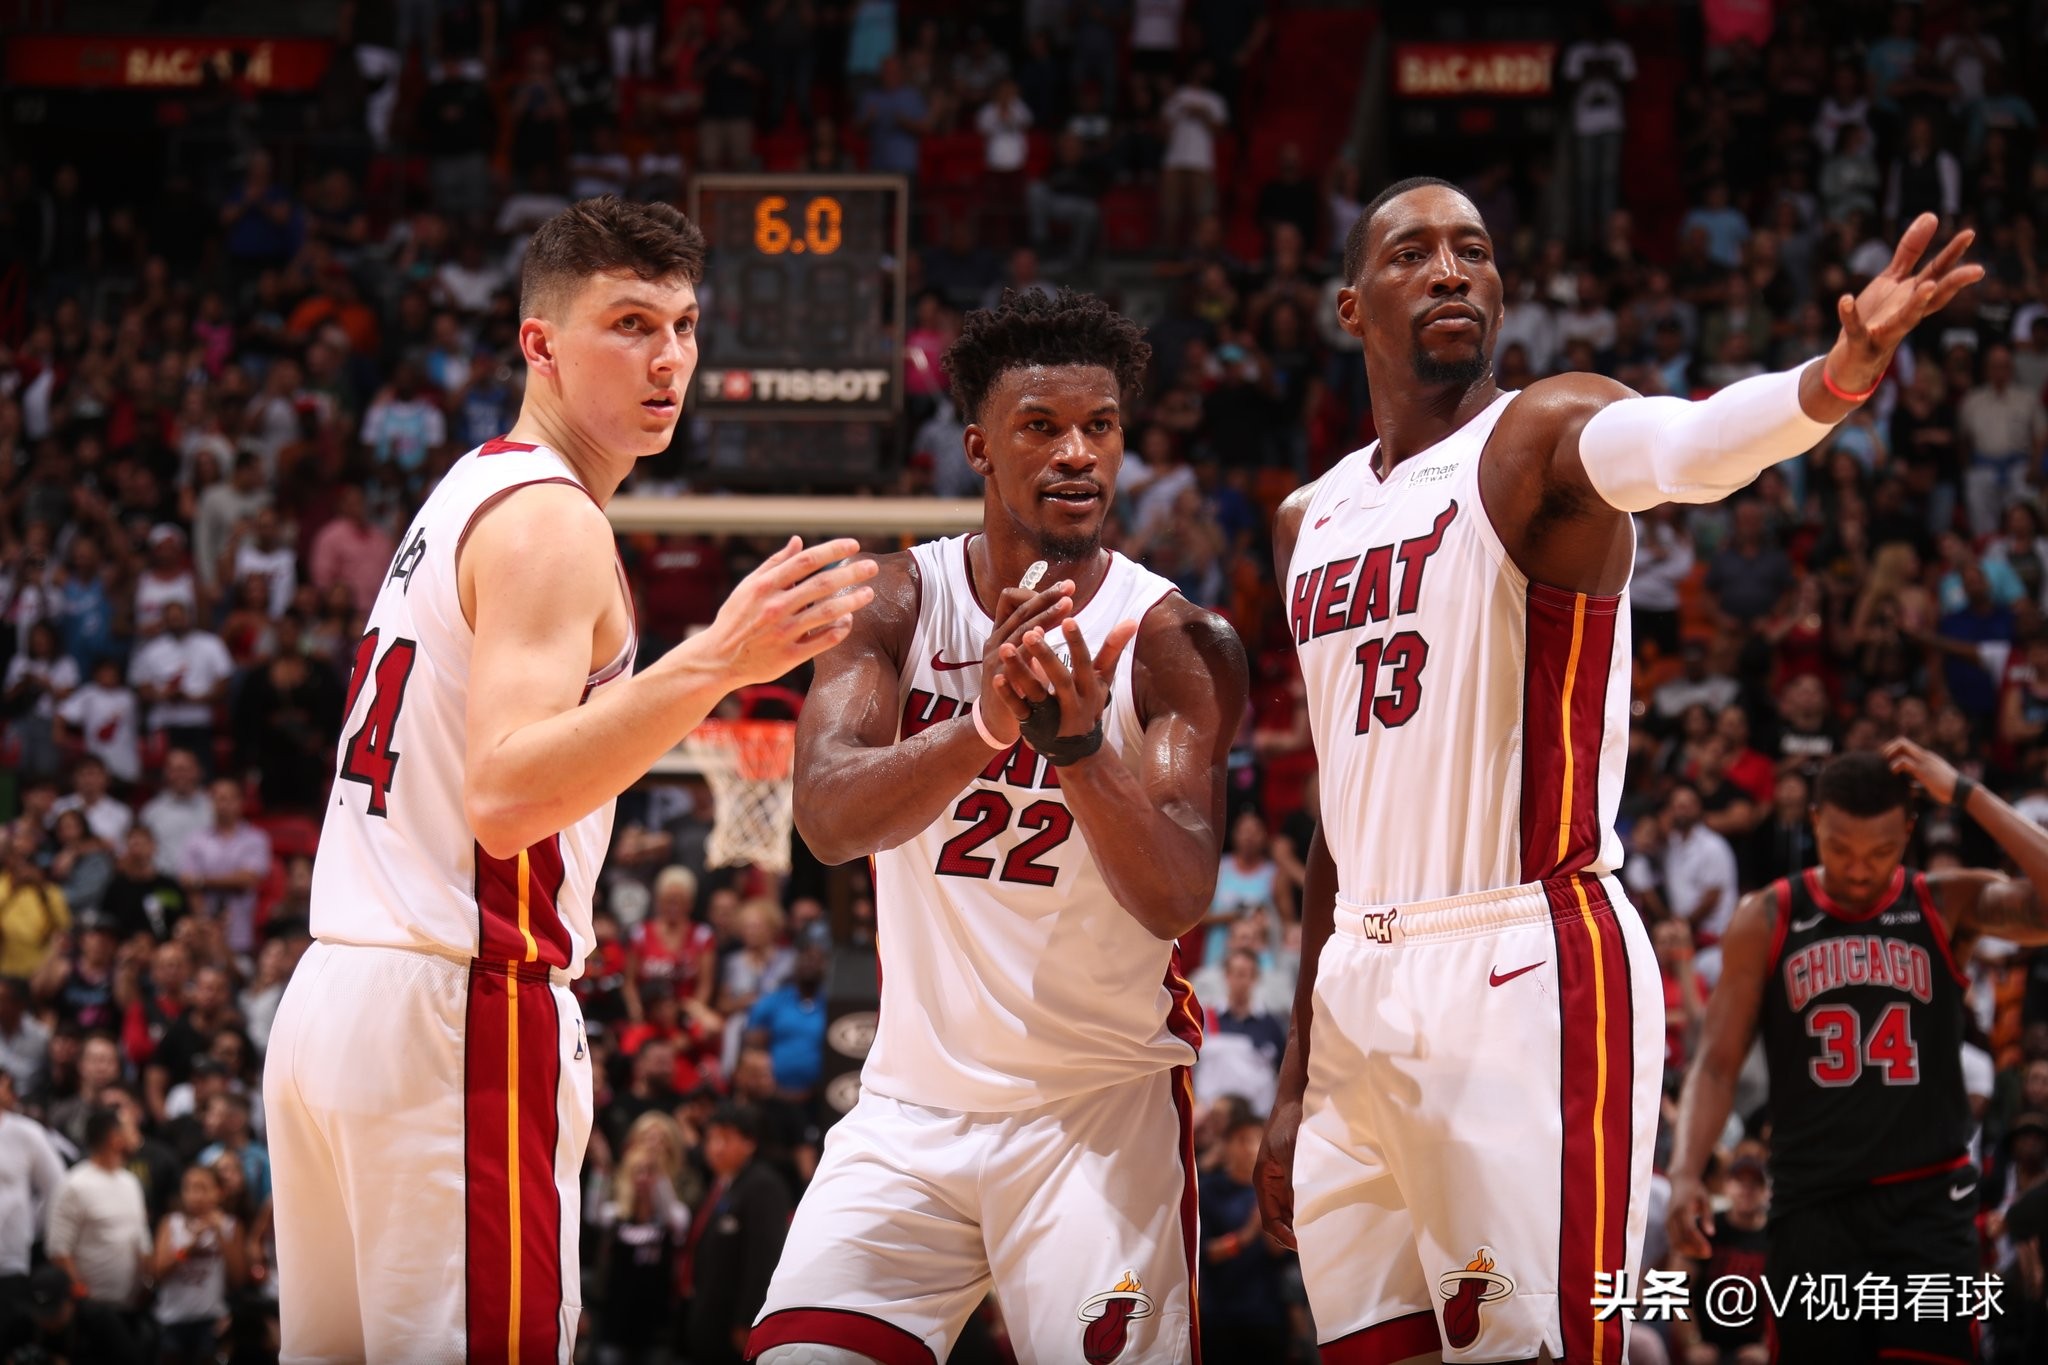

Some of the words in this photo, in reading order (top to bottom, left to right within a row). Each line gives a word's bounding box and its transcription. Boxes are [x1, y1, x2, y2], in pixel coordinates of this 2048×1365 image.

[754, 195, 842, 255] 6.0
[754, 368, 889, 401] TISSOT
[1291, 498, 1459, 647] HEAT
[1355, 630, 1430, 736] 13
[934, 788, 1075, 887] 22
[1783, 934, 1933, 1013] CHICAGO
[1806, 1002, 1920, 1088] 34
